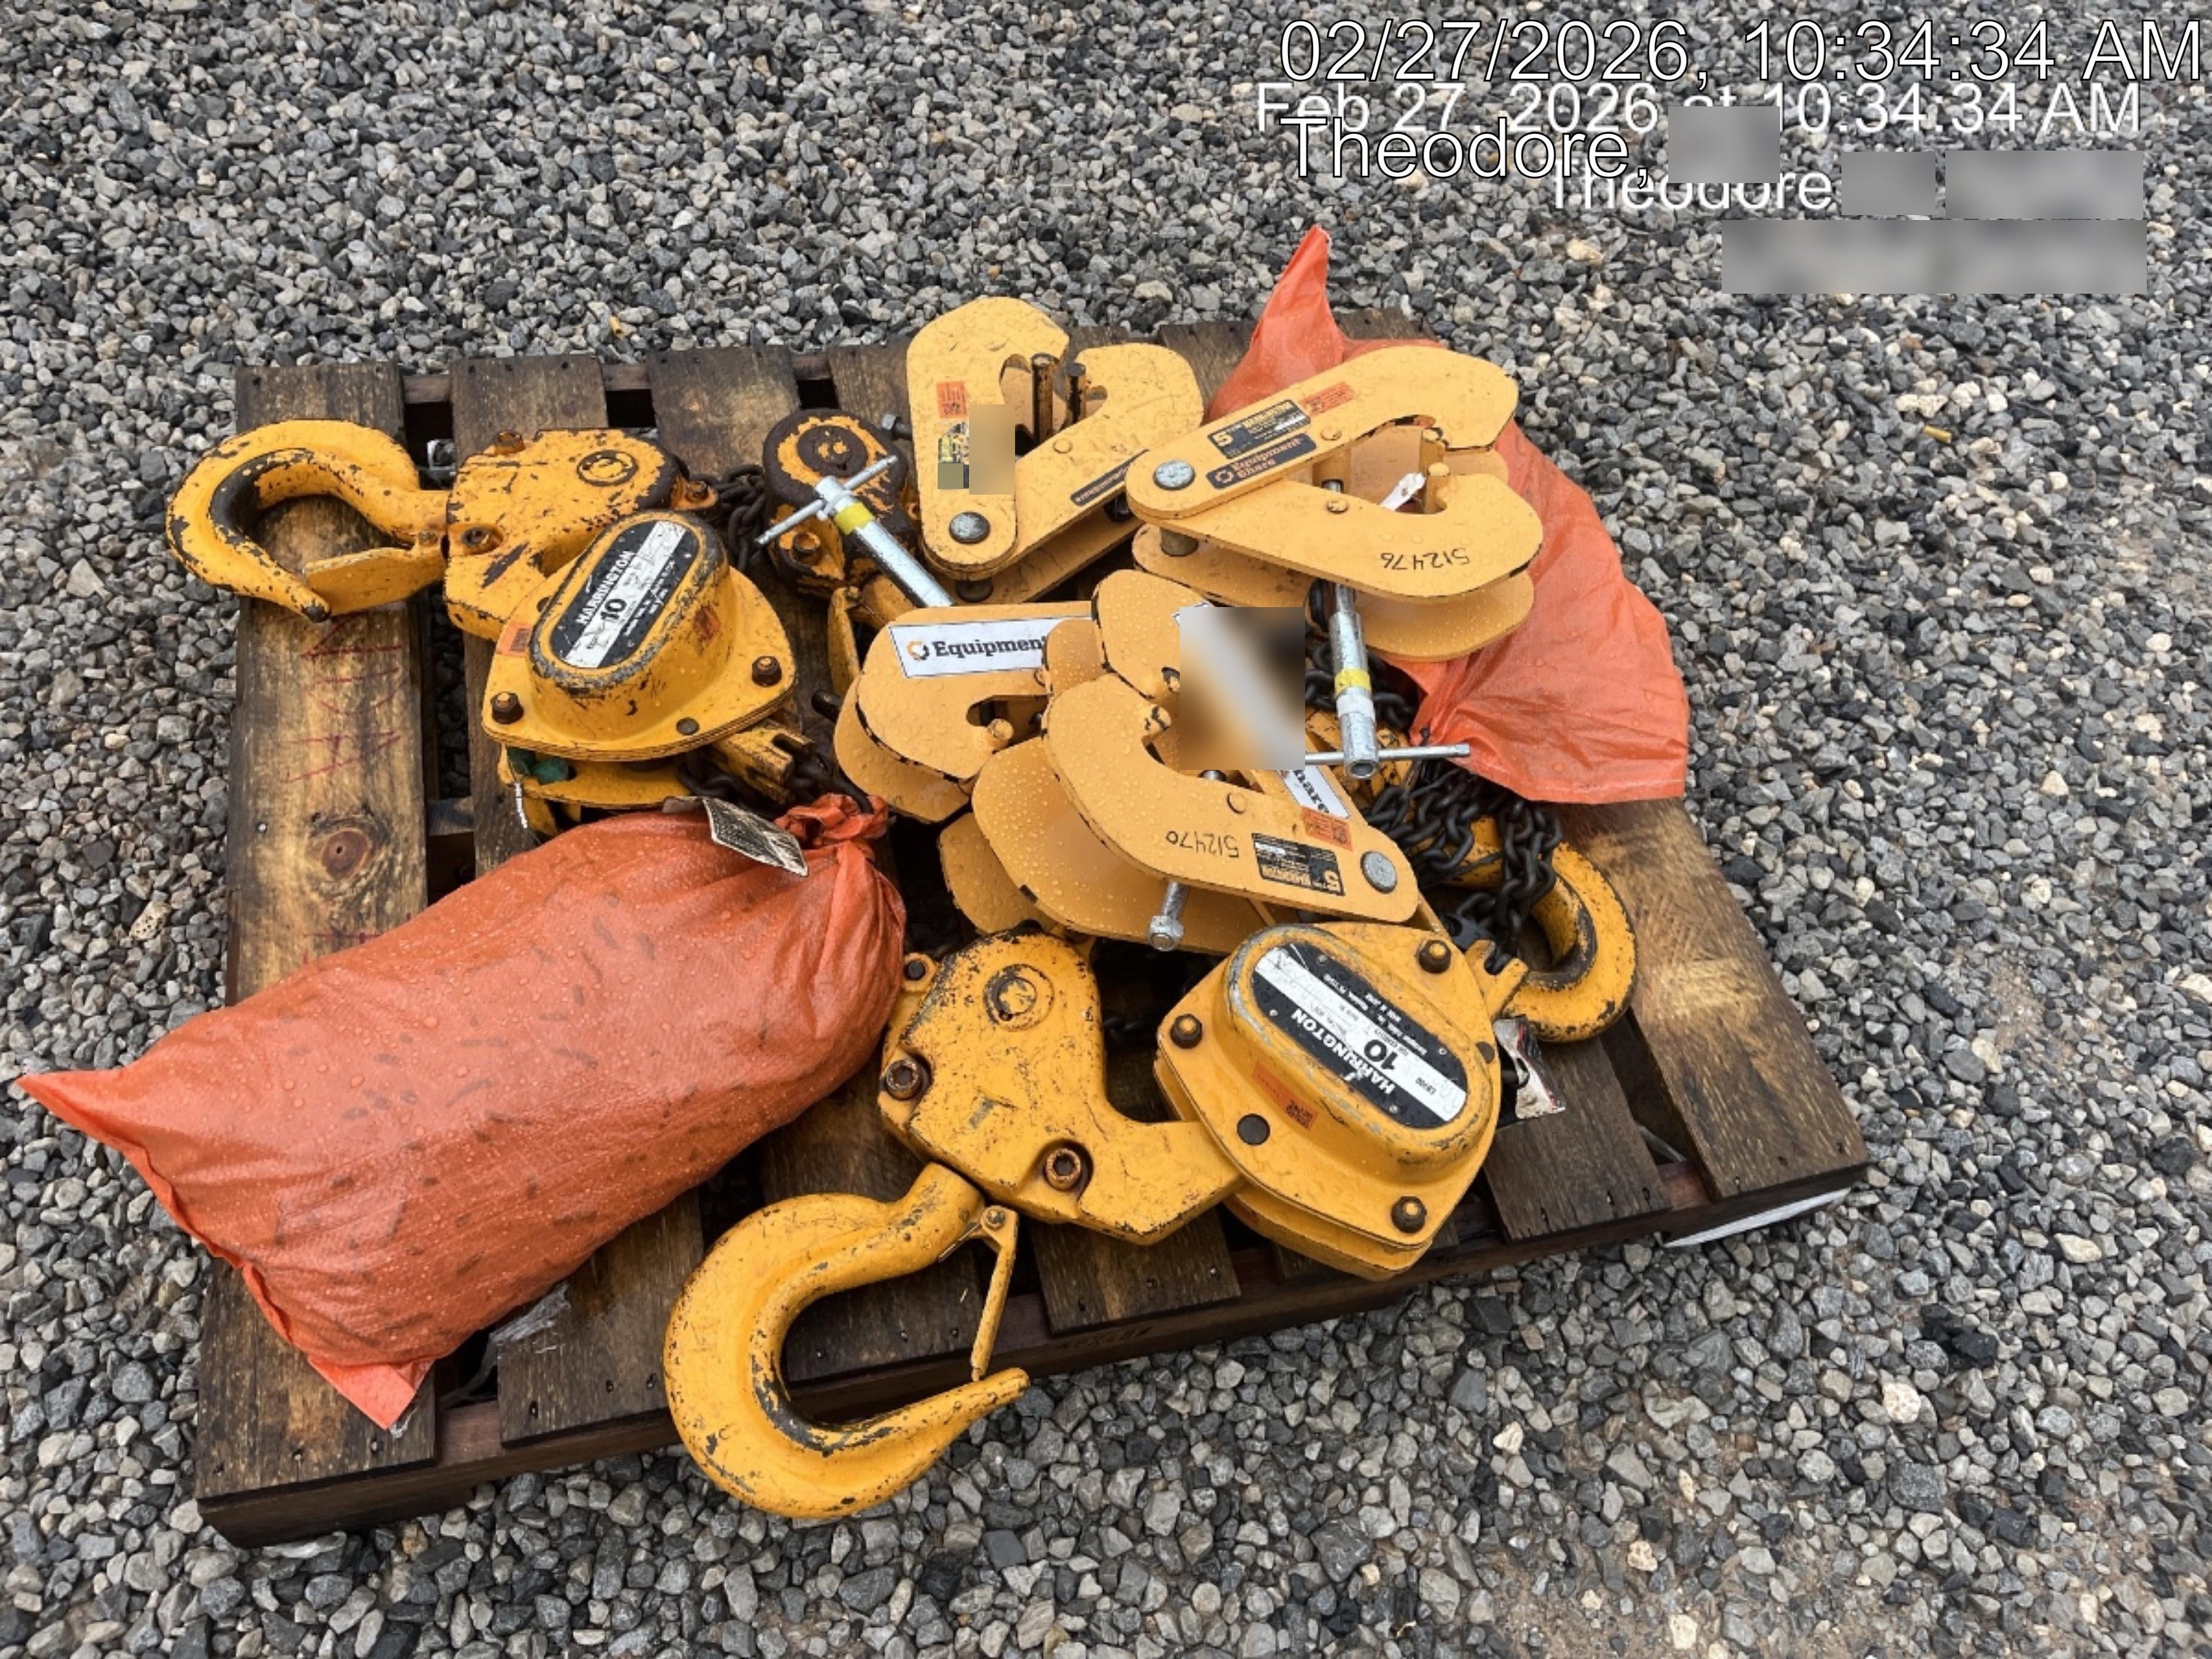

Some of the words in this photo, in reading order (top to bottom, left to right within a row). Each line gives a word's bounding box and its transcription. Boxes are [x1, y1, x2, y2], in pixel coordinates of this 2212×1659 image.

[1232, 437, 1302, 471] Equipment
[1237, 458, 1276, 477] Share
[1381, 547, 1470, 570] 512476
[575, 551, 635, 625] HARRINGTON
[600, 598, 627, 621] 10
[931, 635, 1047, 658] Equipmen
[1292, 770, 1330, 814] hare
[1165, 831, 1239, 858] 512470
[1292, 1008, 1395, 1094] HARRINGTON
[1363, 1040, 1398, 1070] 10
